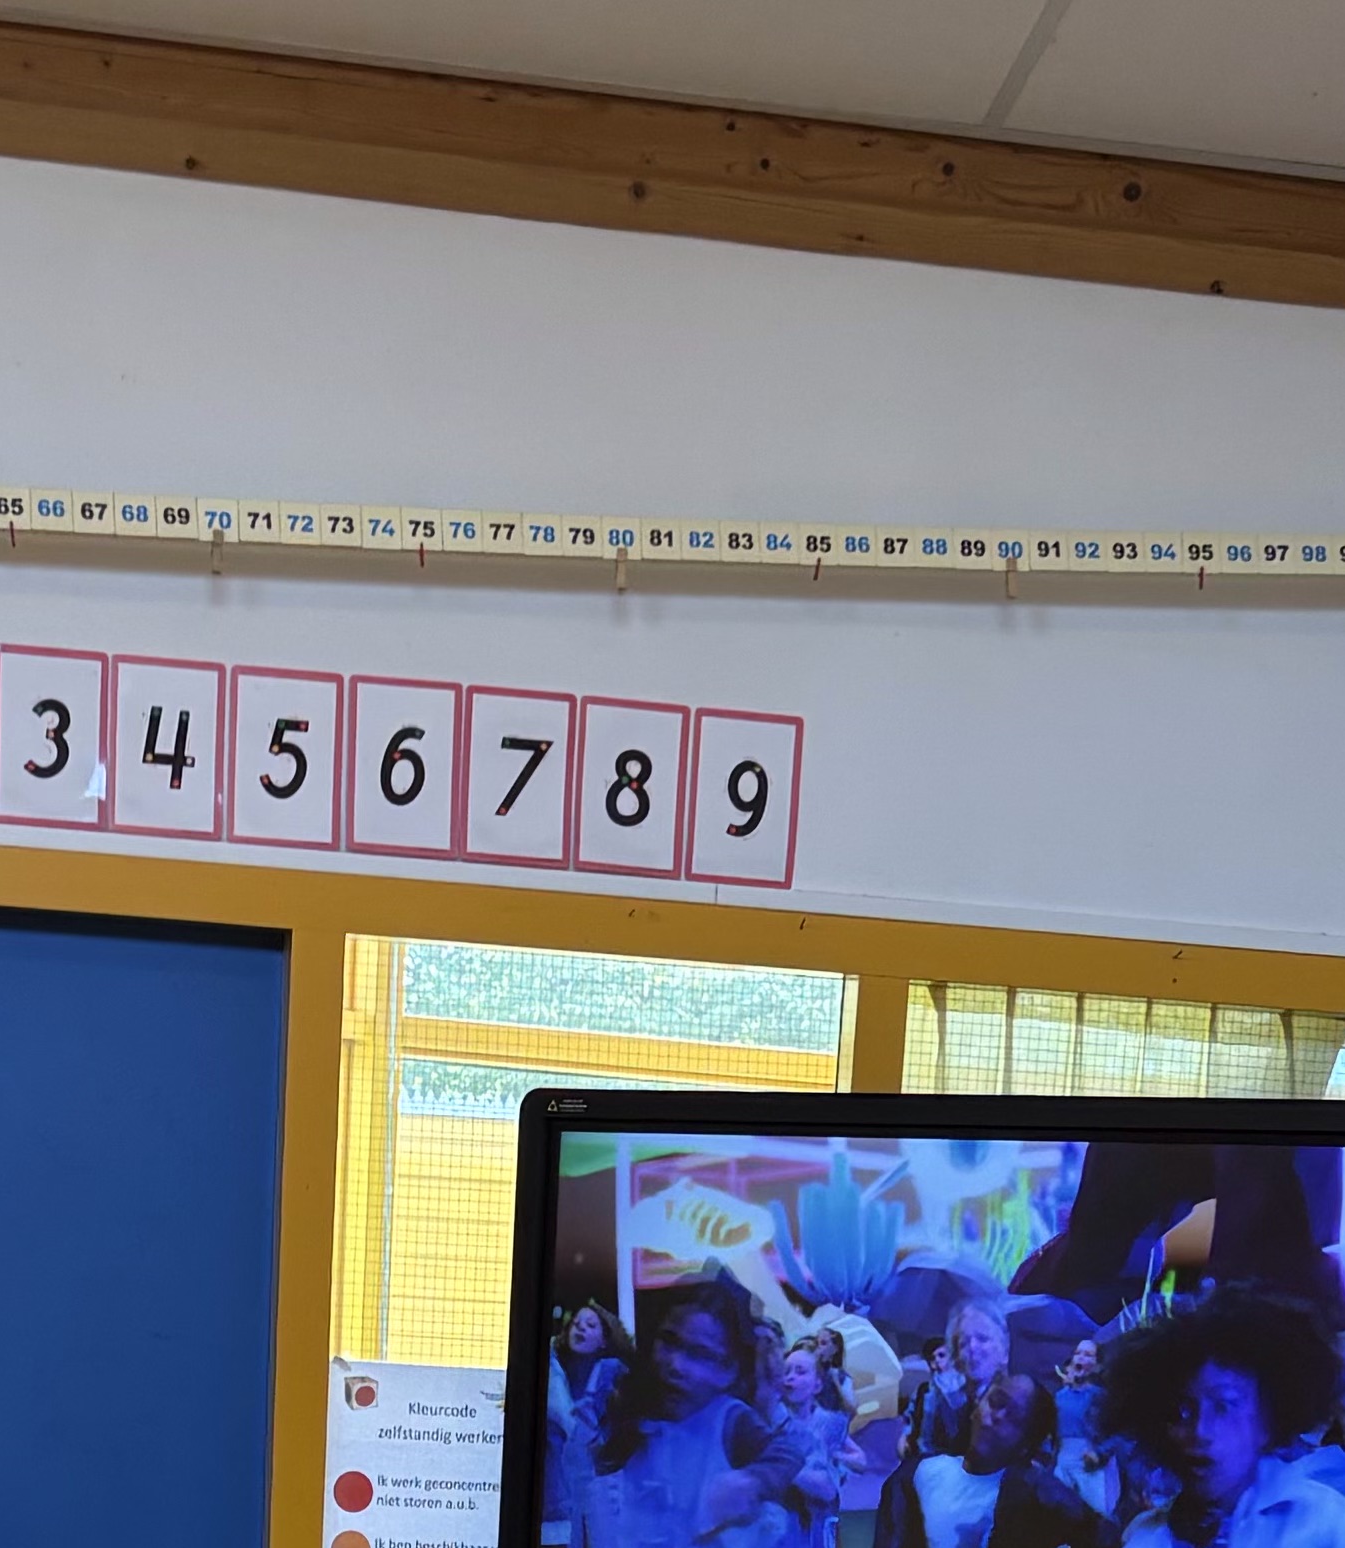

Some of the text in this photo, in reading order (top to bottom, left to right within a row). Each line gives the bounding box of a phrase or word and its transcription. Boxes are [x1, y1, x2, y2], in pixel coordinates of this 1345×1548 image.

[163, 507, 191, 525] 69
[204, 510, 232, 530] 70
[327, 516, 355, 534] 73
[489, 523, 516, 541] 77
[608, 529, 635, 548] 80
[649, 529, 673, 548] 81
[805, 535, 832, 553] 85
[960, 539, 986, 557] 89
[1037, 540, 1061, 558] 91
[1112, 542, 1138, 560] 93
[1263, 544, 1289, 562] 97
[22, 699, 72, 780] 3
[143, 705, 196, 790] 4
[260, 718, 309, 799] 5
[379, 726, 426, 807] 6
[494, 736, 553, 818] 7
[606, 749, 652, 827] 8
[726, 758, 770, 838] 9
[408, 1402, 477, 1419] Kleurcode
[377, 1425, 452, 1445] zelfstandig
[377, 1475, 388, 1487] Ik
[391, 1476, 422, 1489] werk
[376, 1494, 480, 1510] niet storen a.u.b.
